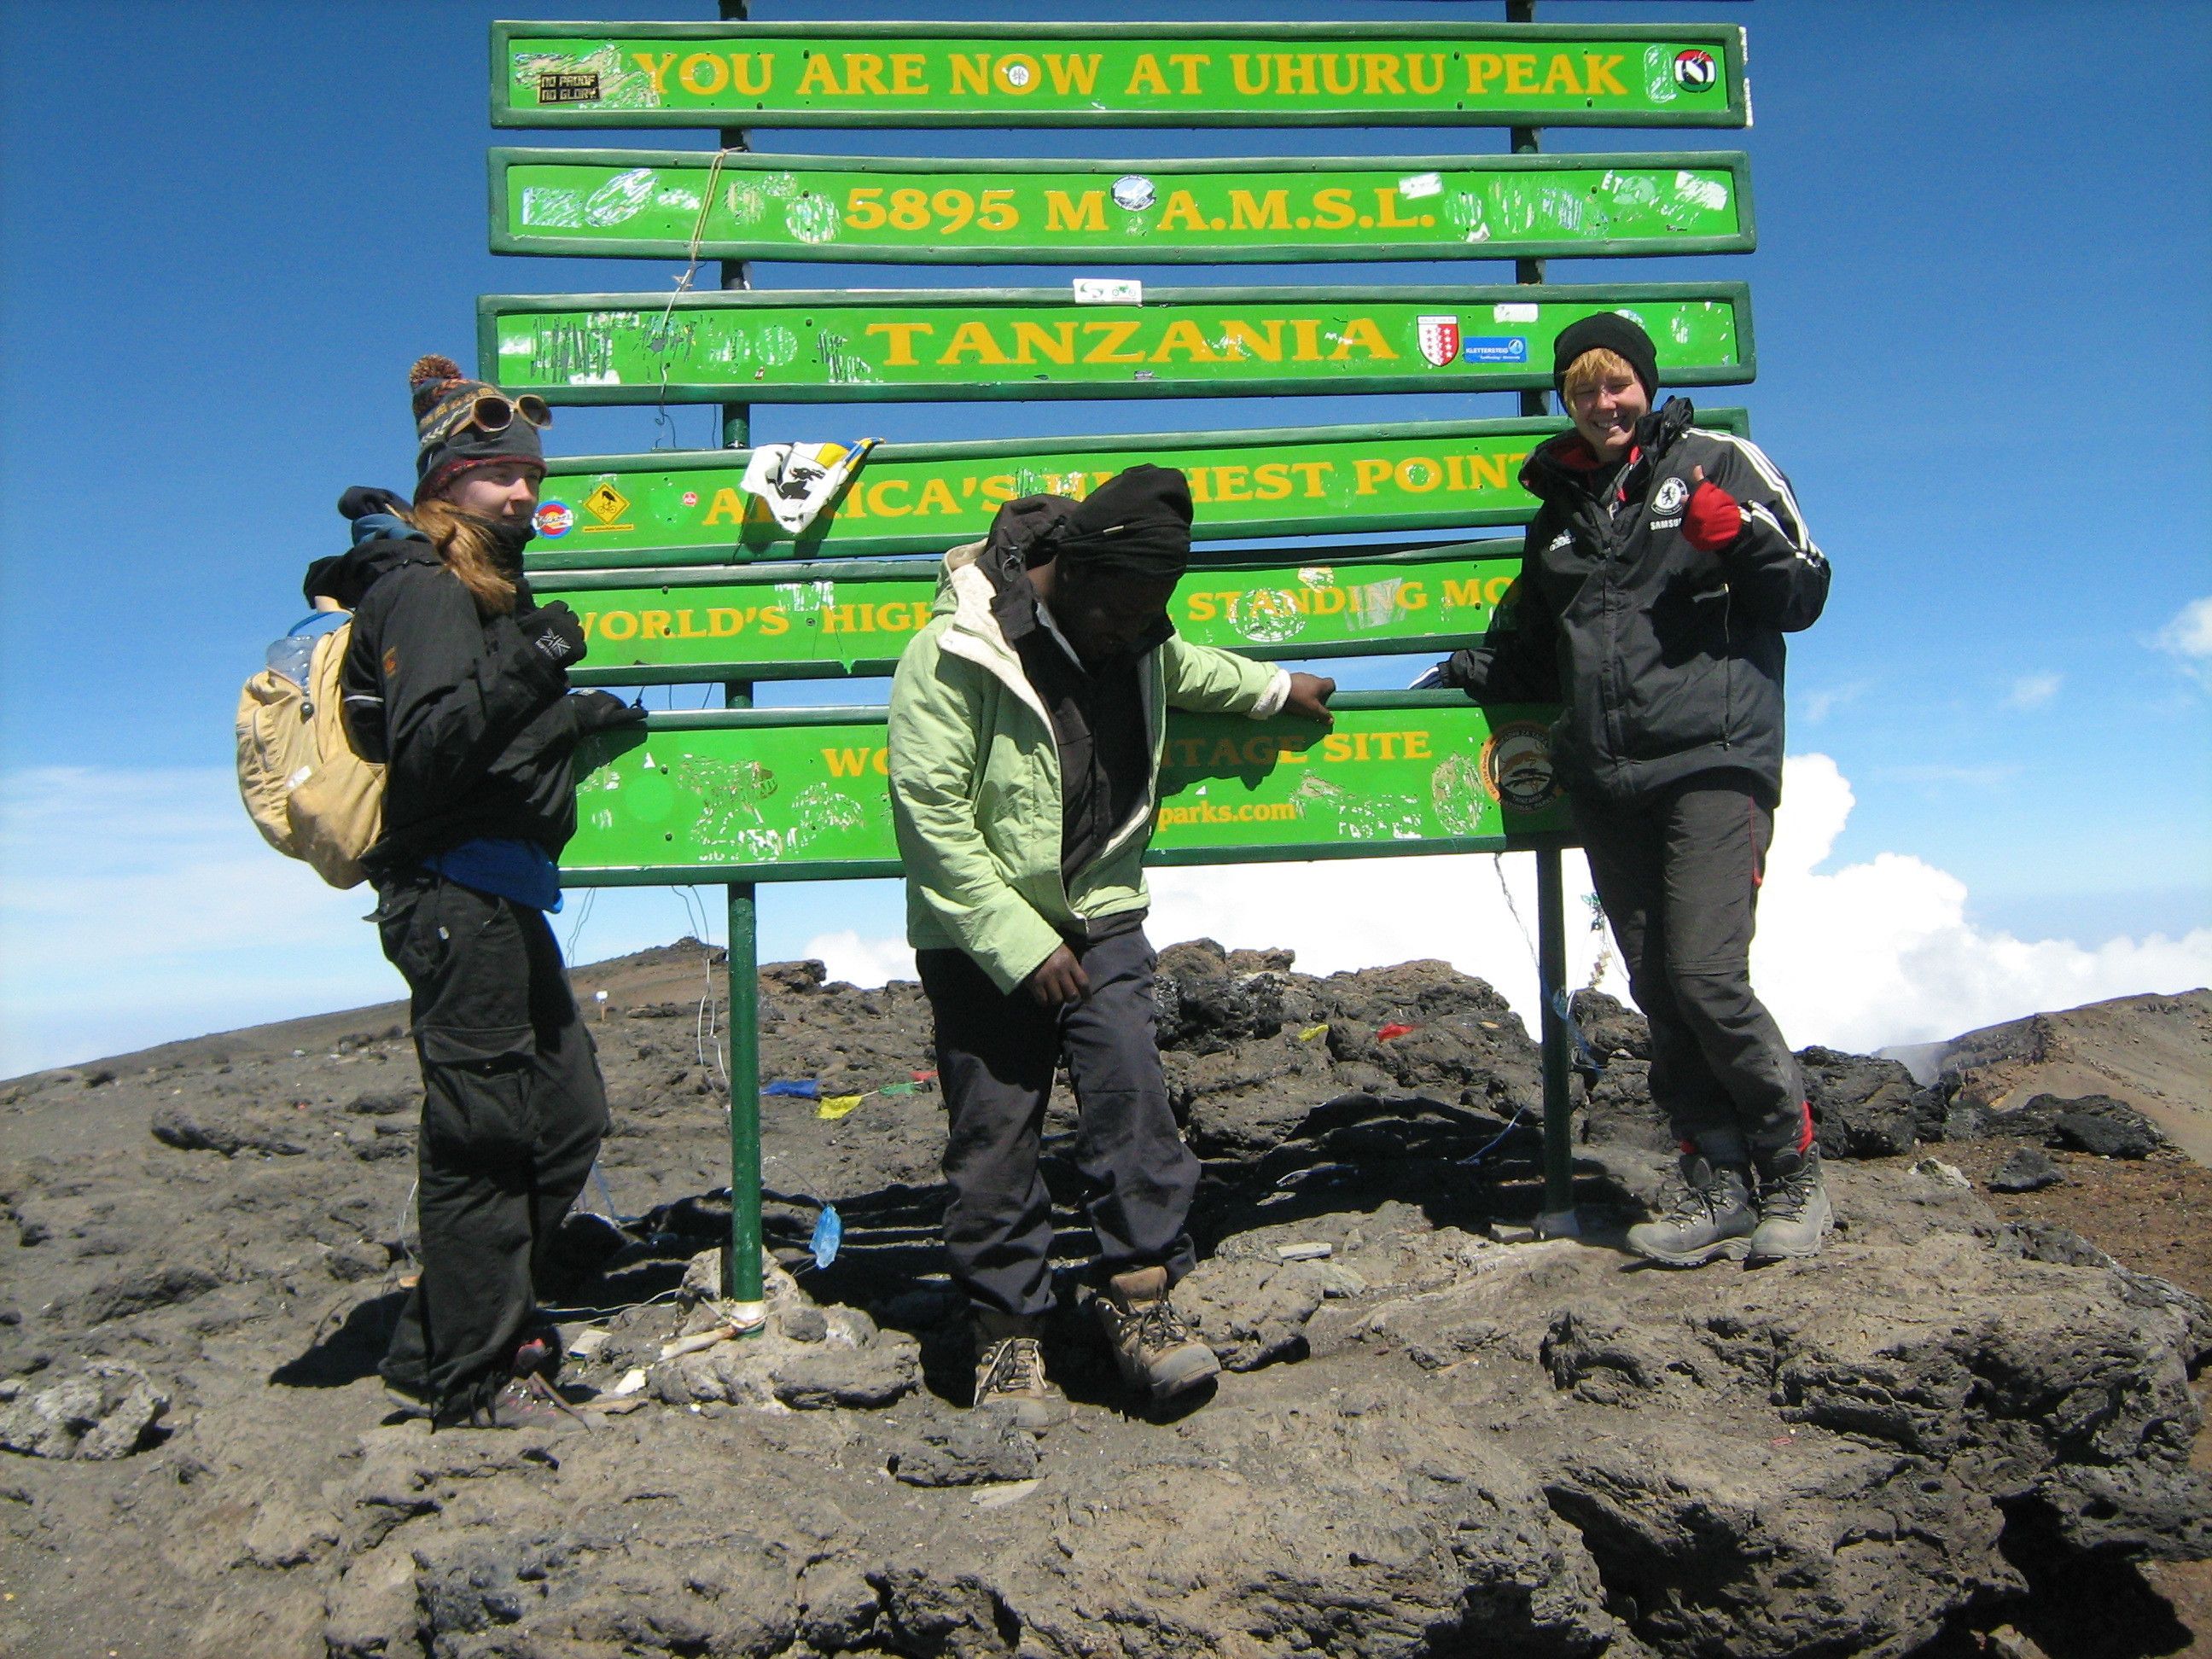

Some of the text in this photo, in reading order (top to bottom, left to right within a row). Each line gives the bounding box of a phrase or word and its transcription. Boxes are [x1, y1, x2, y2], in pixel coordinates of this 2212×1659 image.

[634, 54, 1626, 95] YOU ARE NOW AT UHURU PEAK
[846, 189, 1019, 234] 5895
[1047, 191, 1108, 230] M
[1157, 189, 1435, 230] A.M.S.L.
[866, 318, 1399, 365] TANZANIA
[1650, 517, 1681, 531] SAMSU
[1188, 582, 1428, 620] STANDING
[1162, 735, 1307, 766] ITAGE
[1324, 731, 1432, 762] SITE
[1156, 800, 1296, 832] parks.com
